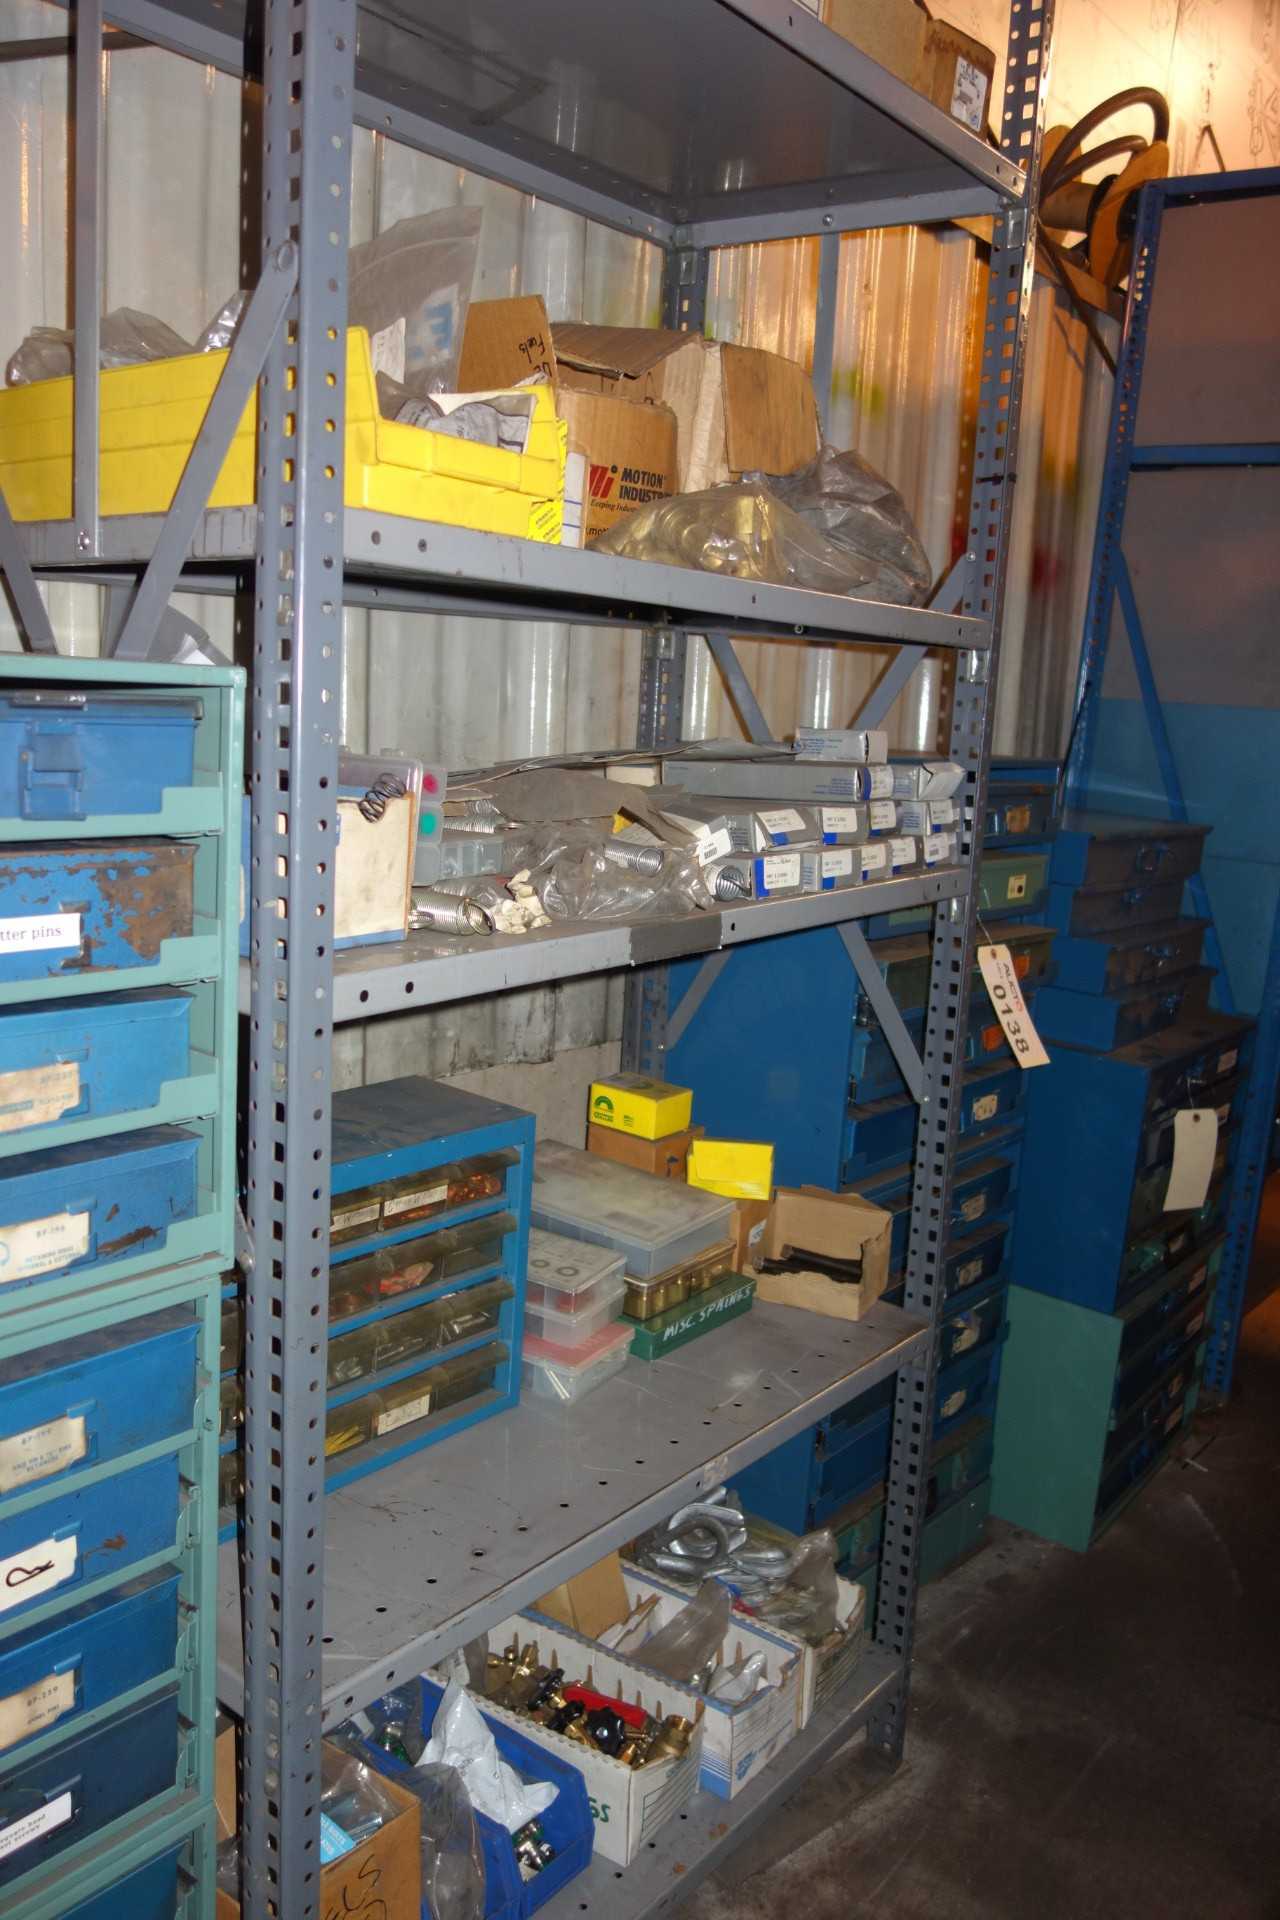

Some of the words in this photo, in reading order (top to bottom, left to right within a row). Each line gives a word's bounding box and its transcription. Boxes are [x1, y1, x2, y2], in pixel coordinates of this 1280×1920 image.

[620, 466, 664, 489] MOTION
[32, 925, 63, 941] pins
[993, 984, 1030, 1053] 0138
[698, 1284, 753, 1323] SPRINGS
